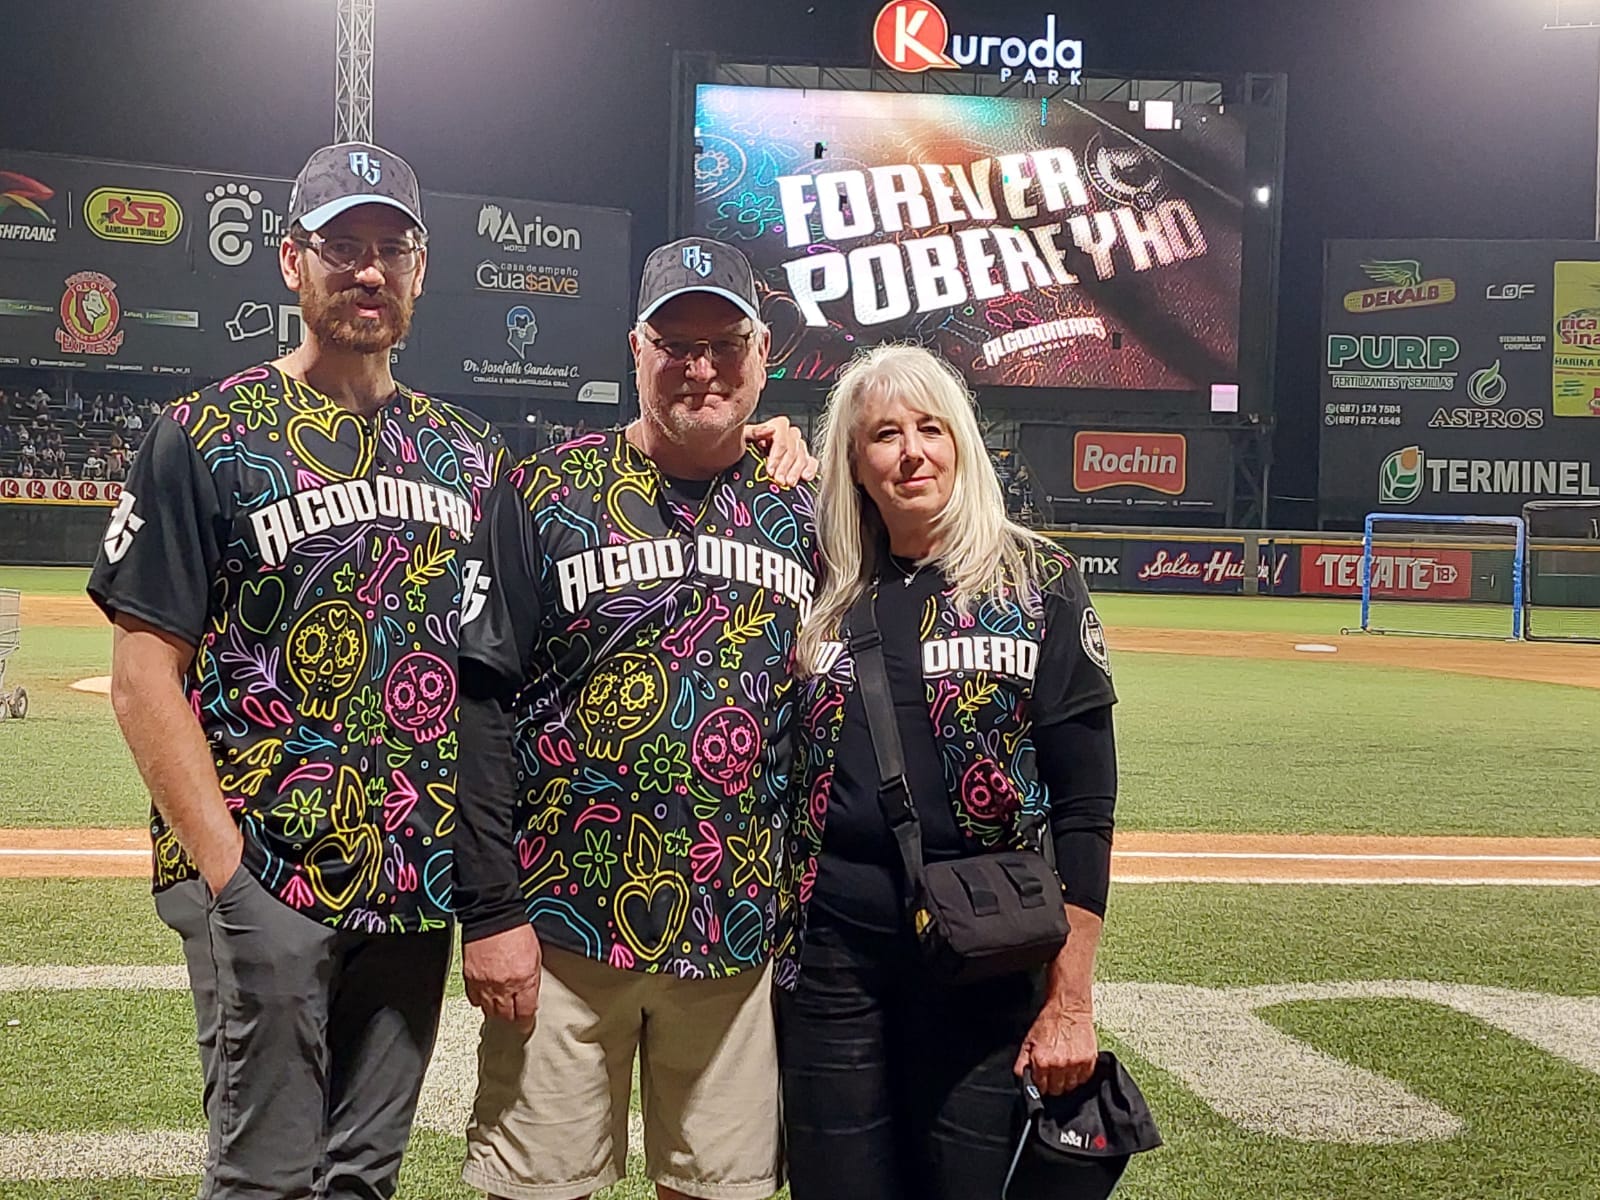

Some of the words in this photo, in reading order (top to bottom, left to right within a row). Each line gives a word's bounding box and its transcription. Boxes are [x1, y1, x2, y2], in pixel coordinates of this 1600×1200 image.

[893, 5, 1083, 69] Kuroda
[1001, 68, 1083, 86] PARK
[776, 146, 1090, 248] FOREVER
[107, 198, 167, 228] RSB
[262, 208, 285, 234] Dr.
[496, 211, 581, 250] Arion
[500, 262, 524, 271] casa
[526, 264, 537, 273] de
[538, 265, 578, 277] empeño
[1361, 286, 1440, 309] DEKALB
[1561, 317, 1597, 330] rica
[982, 316, 1107, 367] ALGODONEROS
[1327, 335, 1460, 369] PURP
[463, 360, 480, 372] Dr.
[523, 362, 568, 377] Sandoval
[1332, 375, 1399, 388] FERTILIZANTES
[1400, 376, 1408, 389] Y
[1407, 376, 1454, 390] SEMILLAS
[1360, 416, 1377, 424] 872
[1361, 405, 1376, 413] 174
[1428, 407, 1544, 429] ASPROS
[1082, 444, 1177, 474] Rochin
[1137, 551, 1201, 581] Salsa
[1315, 553, 1438, 590] TECATE
